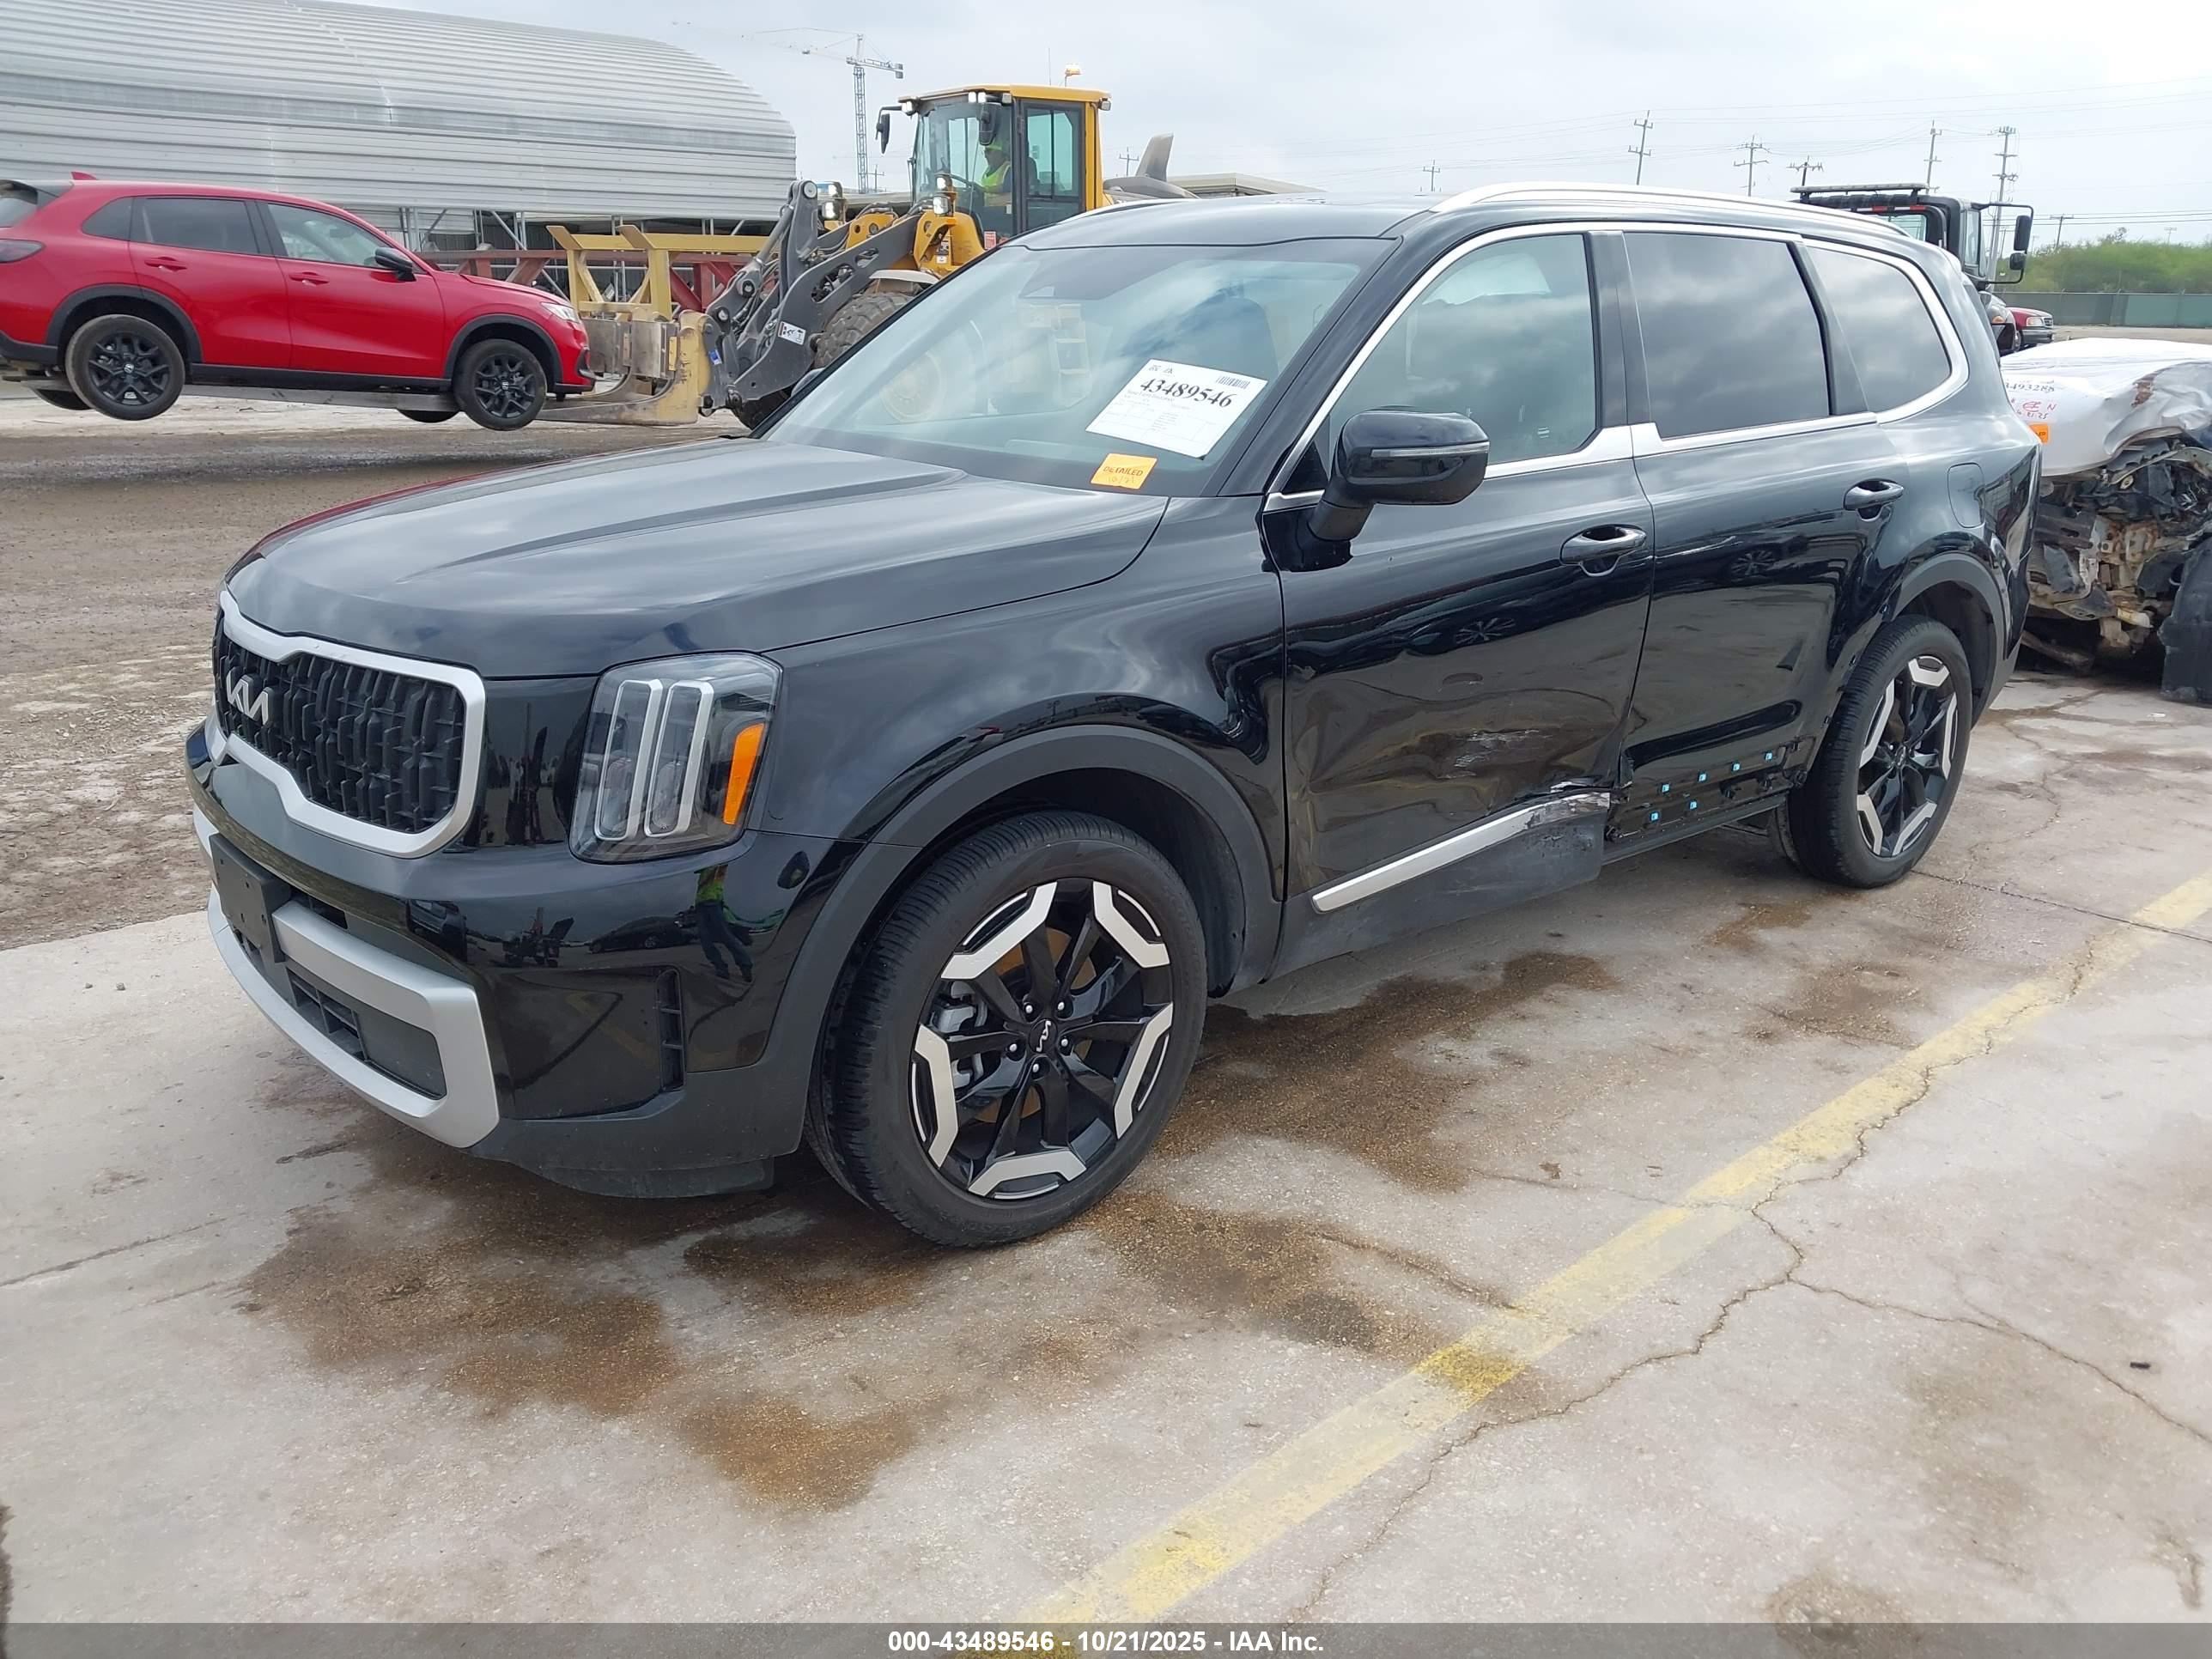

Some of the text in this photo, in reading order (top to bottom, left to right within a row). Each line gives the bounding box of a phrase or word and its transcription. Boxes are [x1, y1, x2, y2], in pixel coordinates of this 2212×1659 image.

[1140, 378, 1237, 408] 43489546
[1103, 466, 1144, 477] DETAILED
[226, 671, 269, 725] KIA
